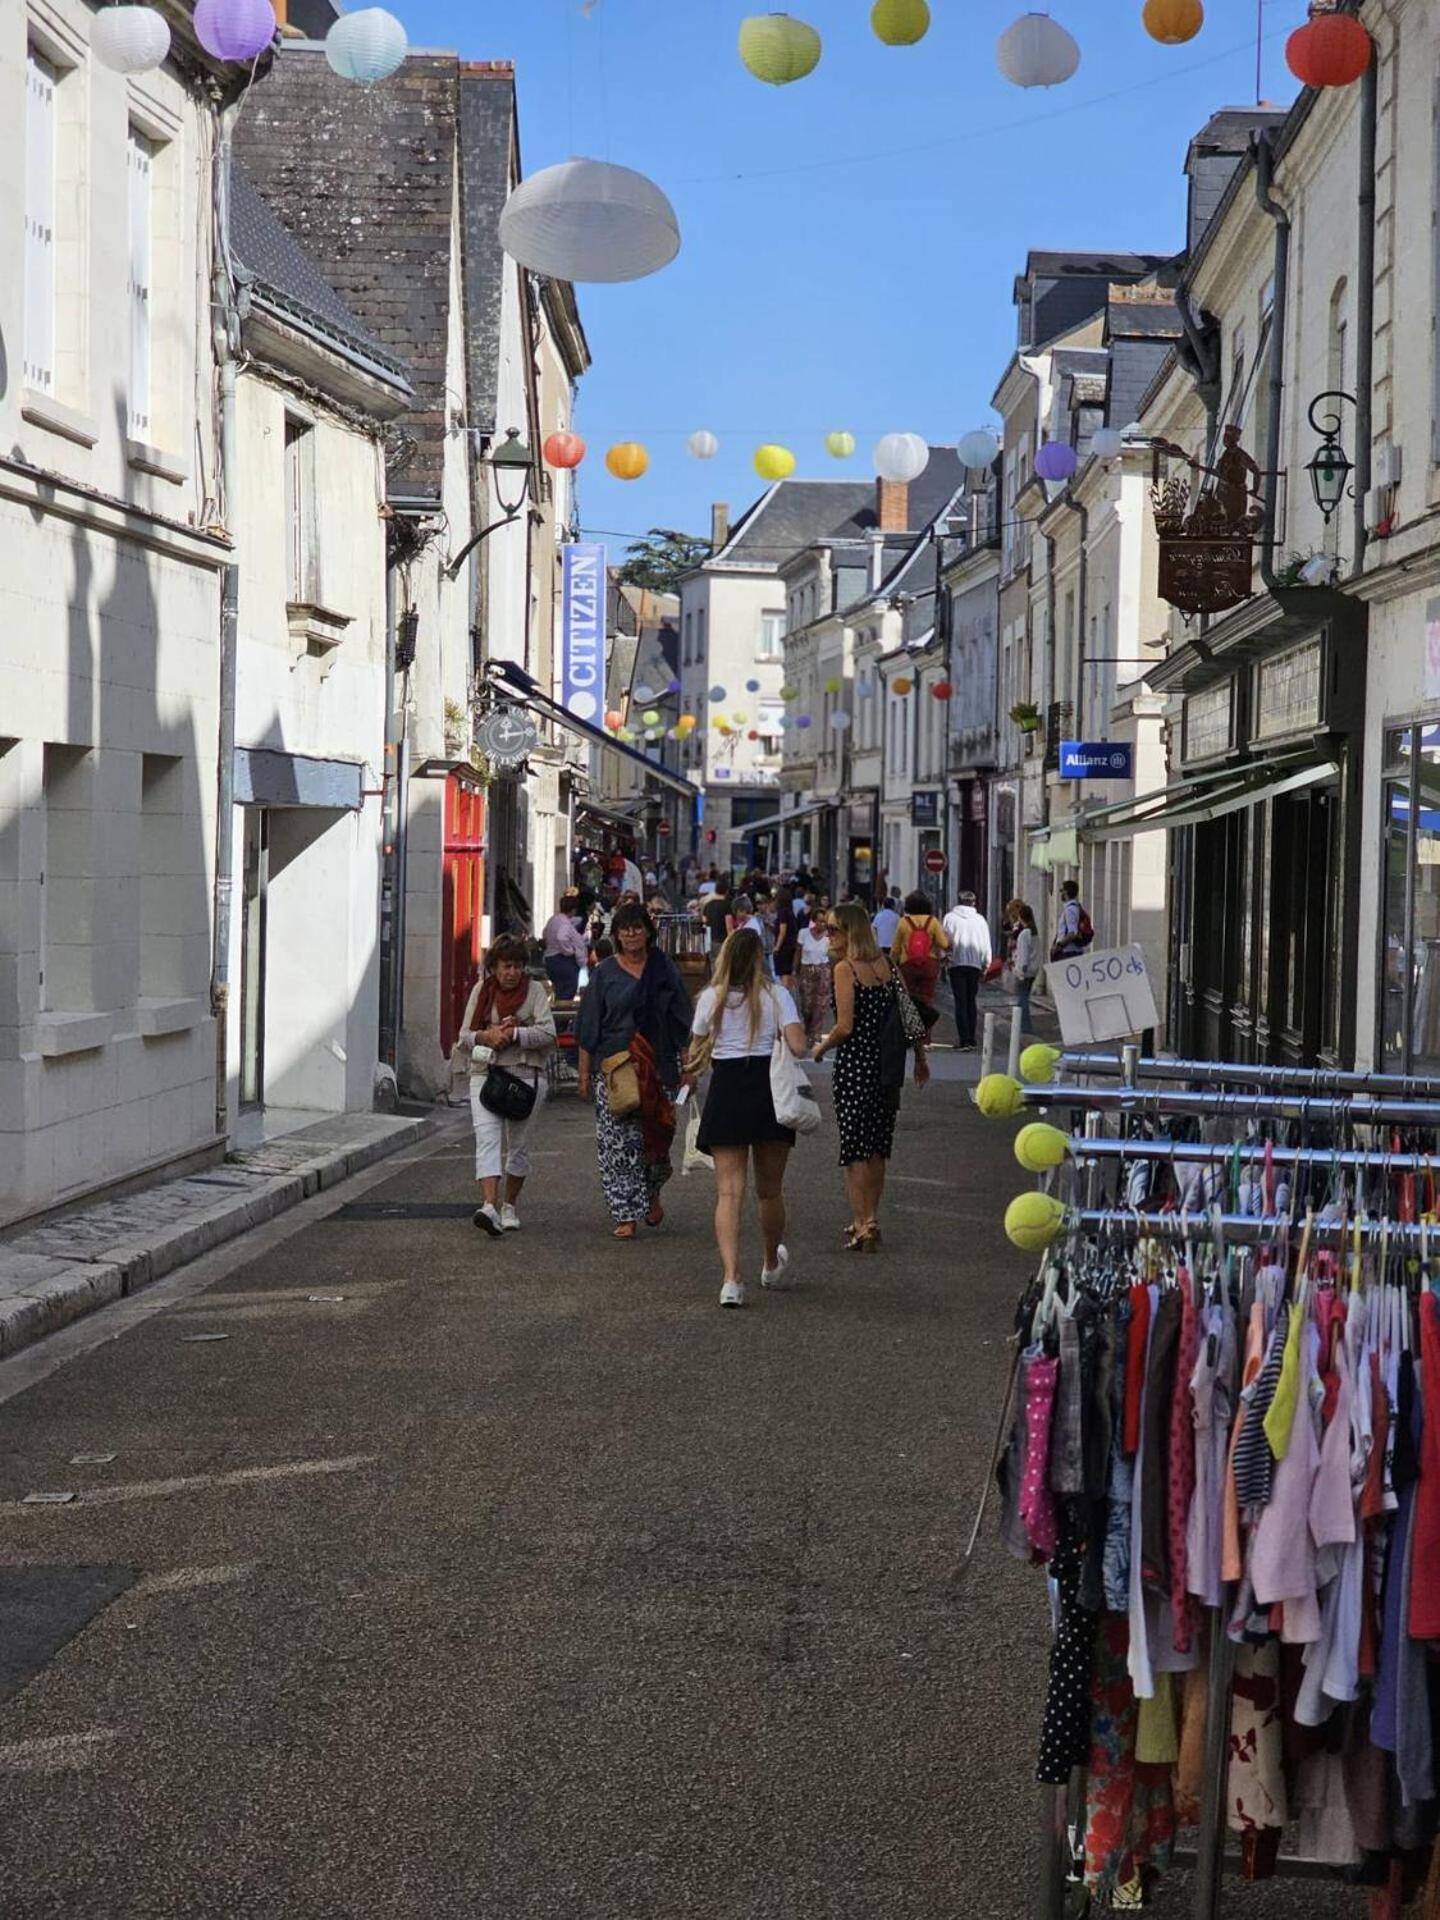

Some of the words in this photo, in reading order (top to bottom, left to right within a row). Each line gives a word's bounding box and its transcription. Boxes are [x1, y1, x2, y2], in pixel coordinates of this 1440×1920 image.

[568, 554, 598, 687] CITIZEN
[1065, 753, 1109, 767] Allianz
[1065, 956, 1123, 991] 0,50
